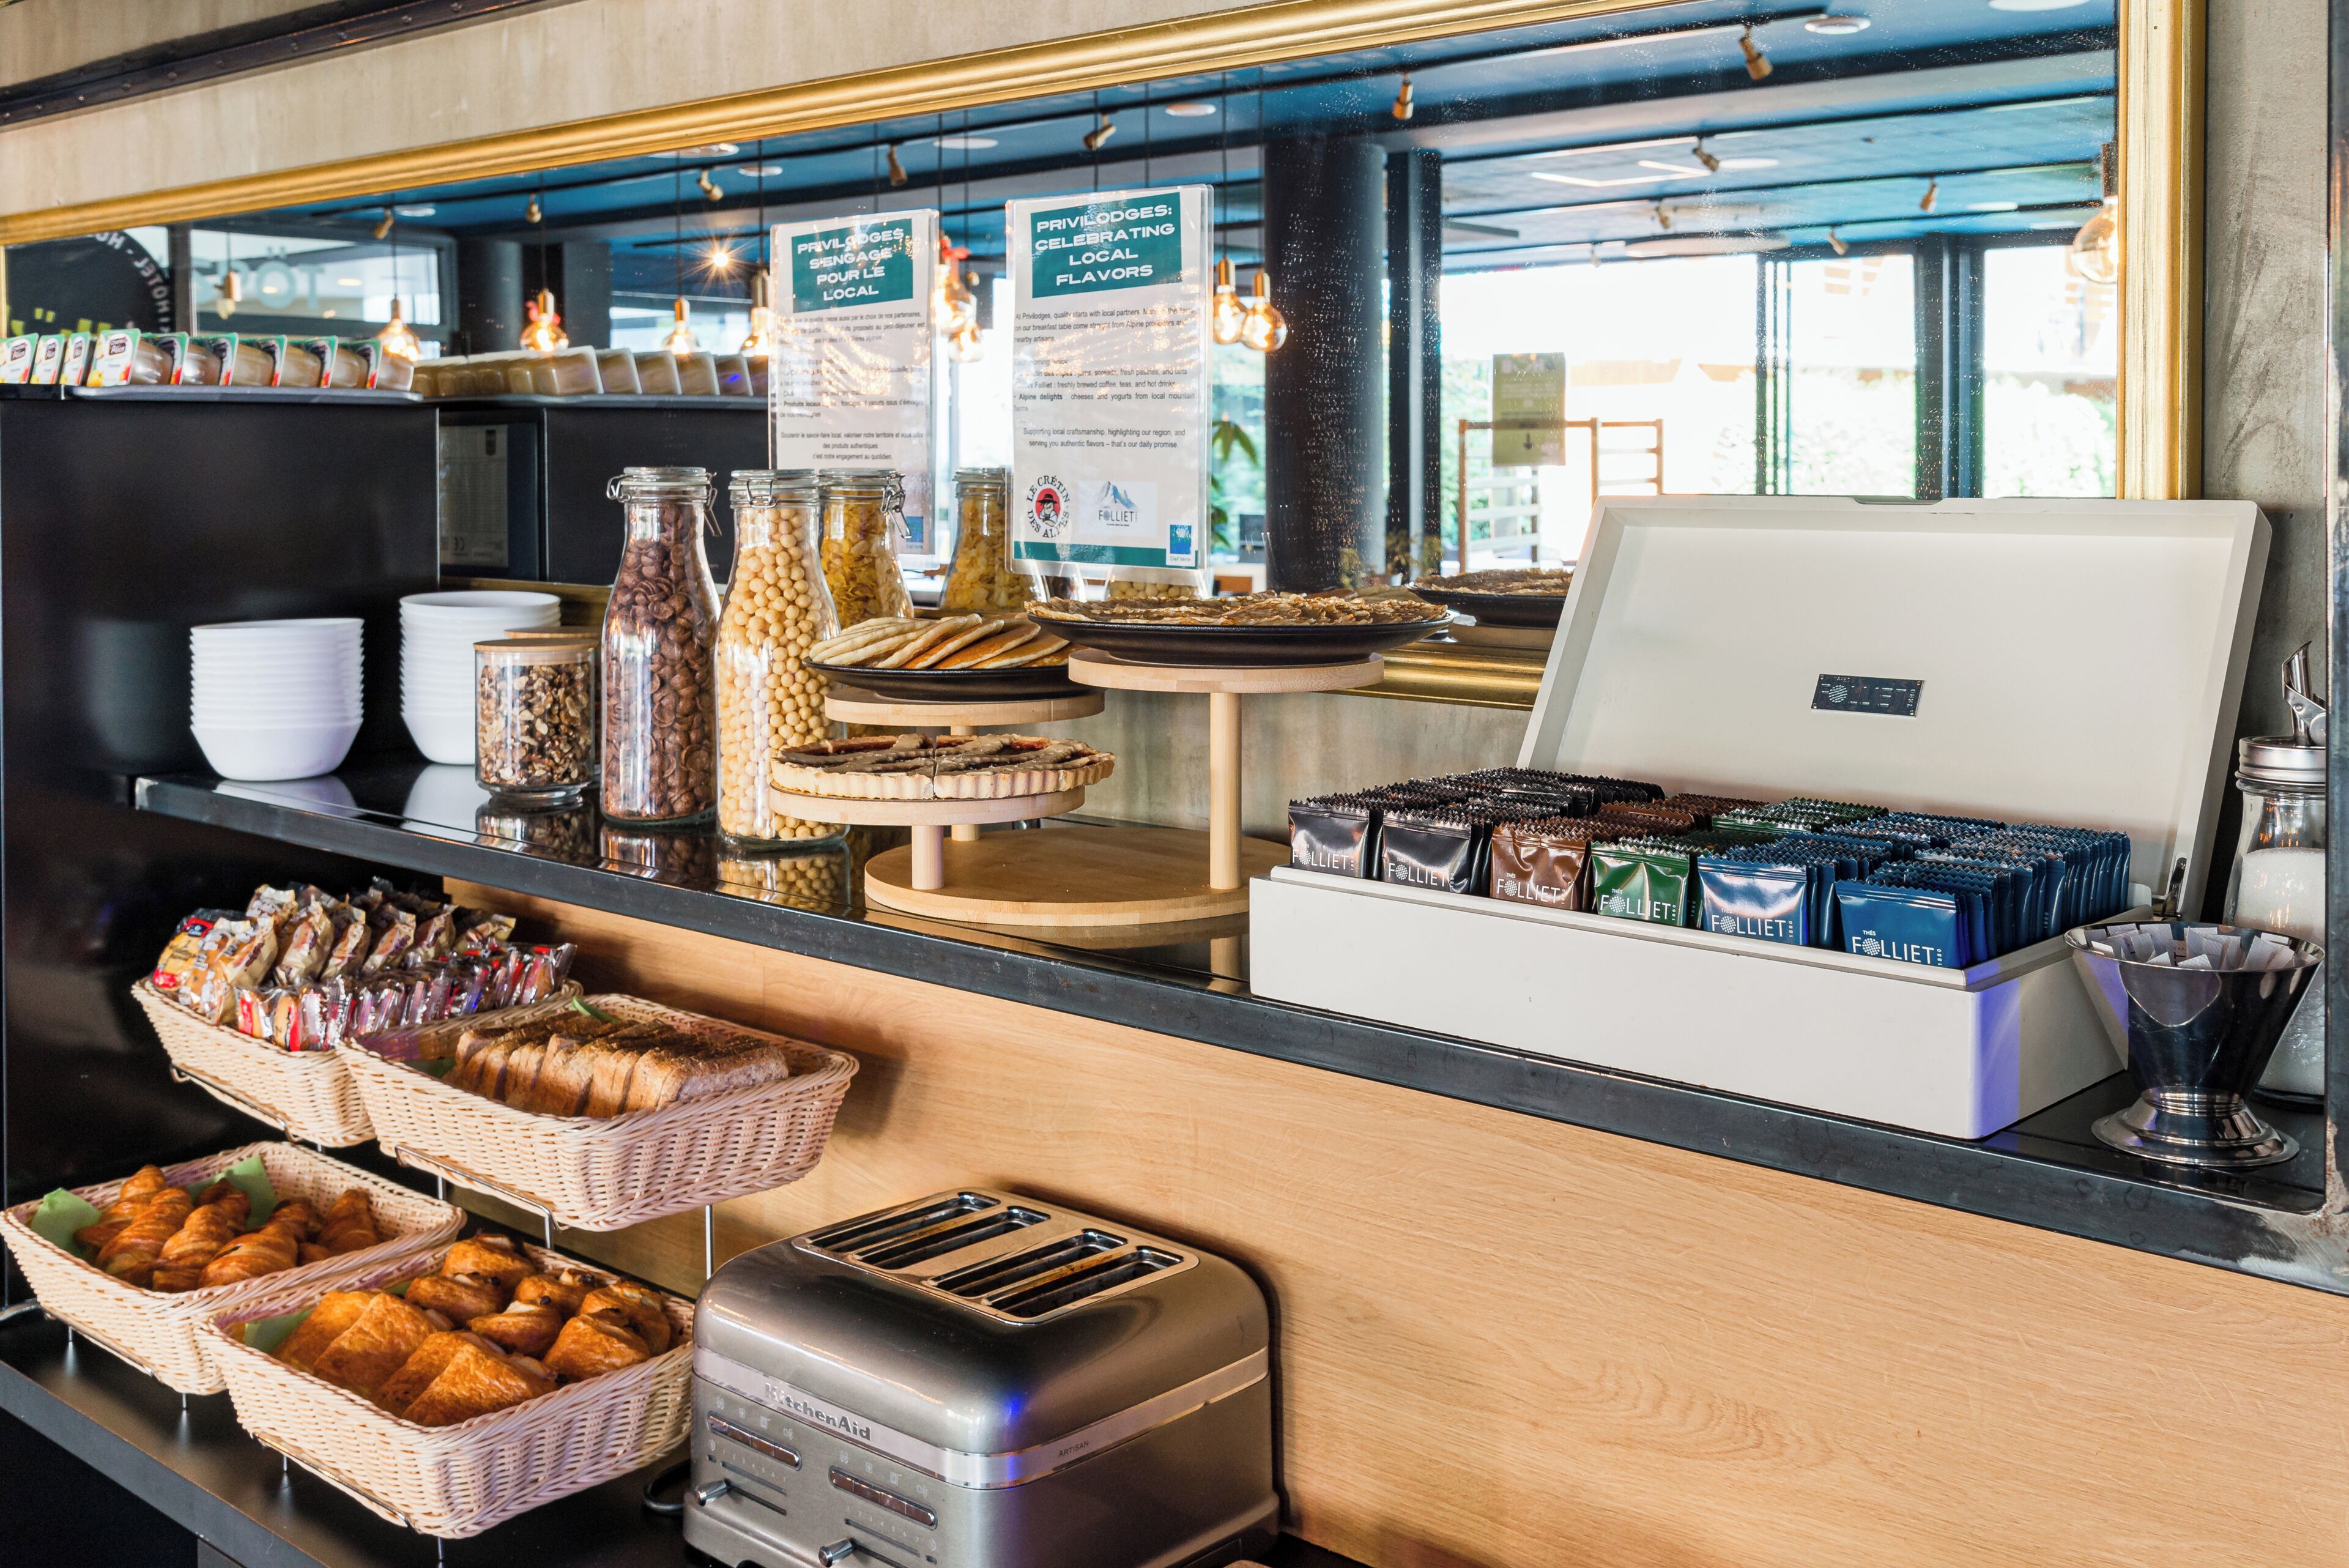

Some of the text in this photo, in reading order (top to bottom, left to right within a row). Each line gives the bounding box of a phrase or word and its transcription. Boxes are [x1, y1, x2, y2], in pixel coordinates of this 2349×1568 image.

[1037, 204, 1172, 232] PRIVILODGES:
[1035, 223, 1175, 251] CELEBRATING
[1069, 248, 1138, 266] LOCAL
[817, 266, 885, 285] POUR LE
[1056, 264, 1153, 286] FLAVORS
[823, 285, 879, 301] LOCAL
[1126, 320, 1144, 329] Alpine
[1040, 393, 1063, 401] delights
[1111, 392, 1131, 401] yogurts
[1023, 428, 1051, 436] Supporting
[1108, 428, 1140, 437] highlighting
[1138, 440, 1152, 449] daily
[1026, 475, 1070, 502] LE CRÉTIN
[1028, 508, 1070, 538] DES ALPES
[1099, 510, 1134, 522] FOLLIET
[1292, 850, 1349, 870] FOLLIET
[1388, 862, 1446, 886] FOLLIET
[1497, 878, 1560, 904] FOLLIET
[1600, 894, 1671, 920] FOLLIET
[1712, 915, 1786, 937] FOLLIET
[1852, 936, 1934, 965] FOLLIET
[765, 1382, 872, 1441] KitchenAid
[1058, 1440, 1089, 1458] ARTISAN
